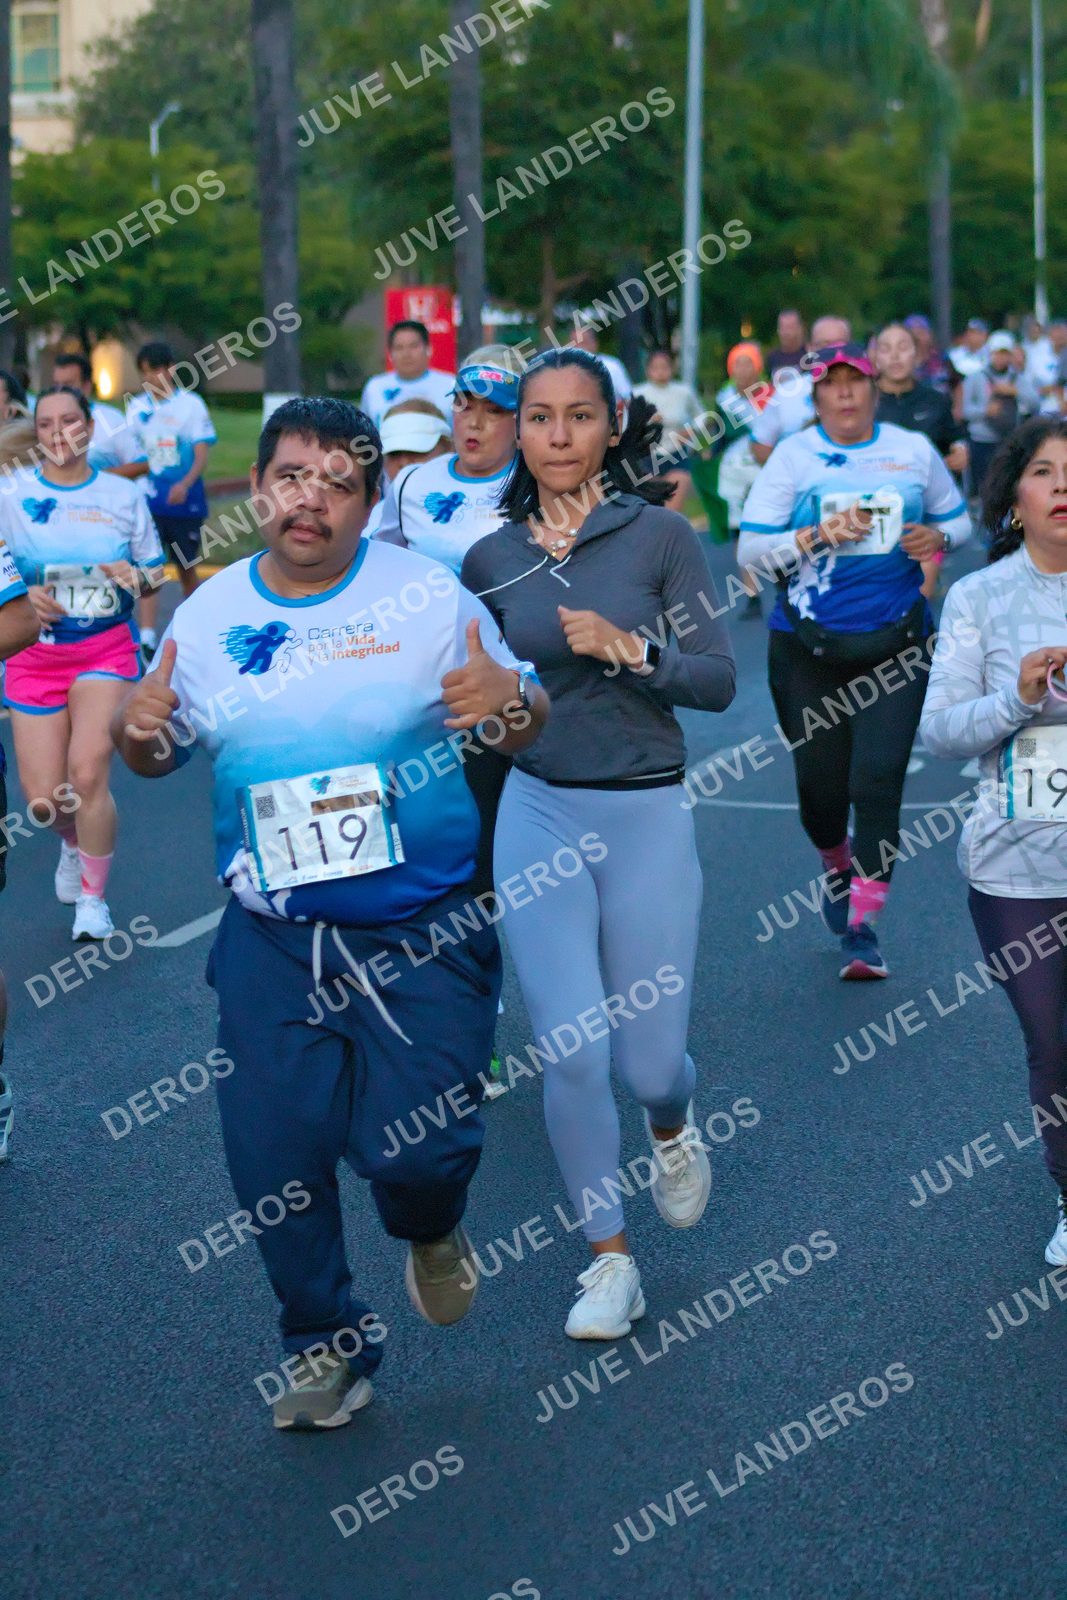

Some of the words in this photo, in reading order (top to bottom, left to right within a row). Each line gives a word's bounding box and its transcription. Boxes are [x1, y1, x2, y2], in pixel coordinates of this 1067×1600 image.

[308, 622, 374, 641] Carrera
[346, 633, 376, 647] Vida
[333, 641, 400, 661] Integridad
[278, 814, 368, 870] 119
